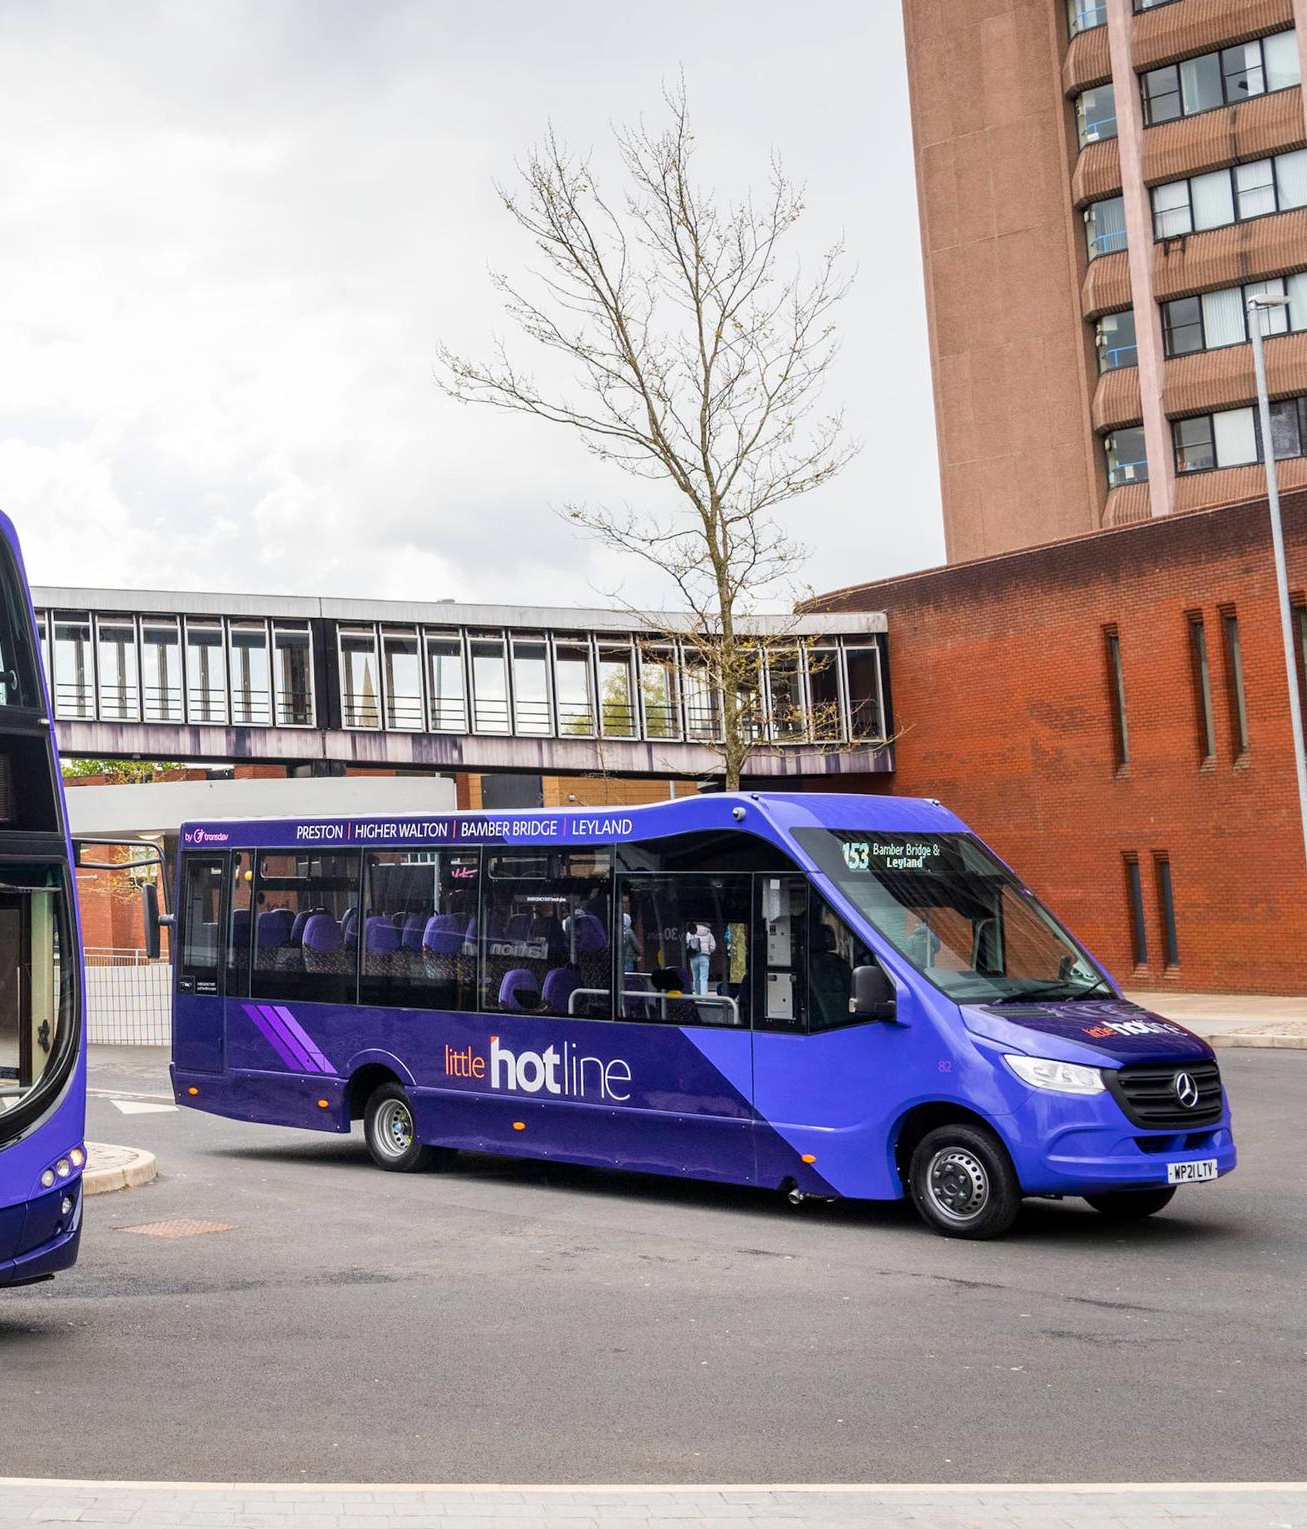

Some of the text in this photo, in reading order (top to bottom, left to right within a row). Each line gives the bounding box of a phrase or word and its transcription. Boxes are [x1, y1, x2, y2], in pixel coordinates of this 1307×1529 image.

[296, 825, 343, 839] PRESTON
[355, 822, 448, 838] HIGHER WALTON
[461, 820, 558, 837] BAMBER BRIDGE
[572, 819, 633, 835] LEYLAND
[185, 832, 192, 843] by
[842, 842, 869, 870] 153
[873, 843, 940, 858] Bamber Bridge &
[886, 856, 923, 869] Leyland
[445, 1036, 631, 1100] little hotline
[938, 1060, 952, 1073] 82
